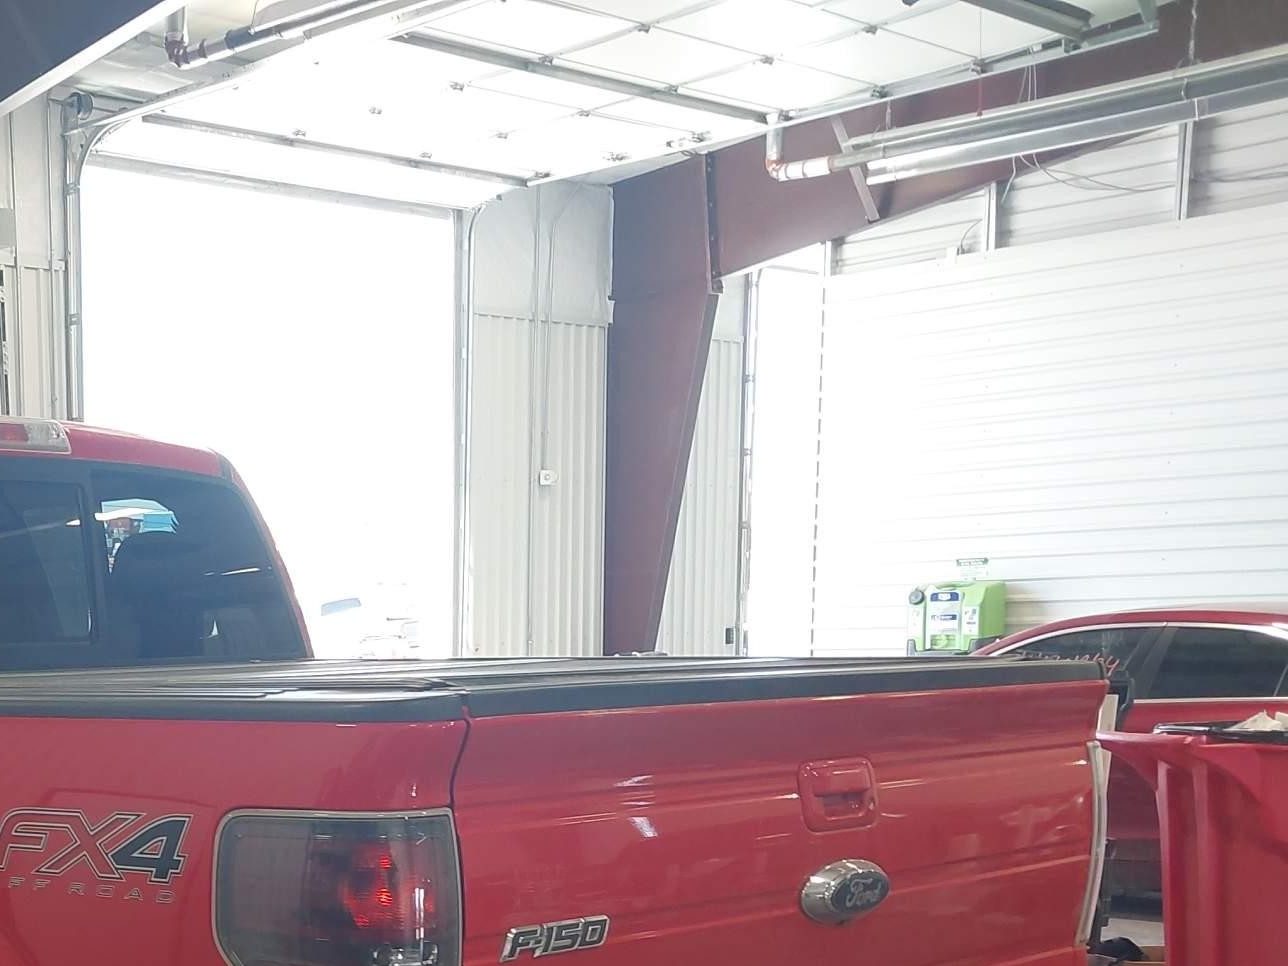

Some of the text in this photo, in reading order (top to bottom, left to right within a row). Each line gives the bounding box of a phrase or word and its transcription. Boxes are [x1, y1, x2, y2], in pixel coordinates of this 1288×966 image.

[67, 882, 177, 904] ROAD
[845, 877, 883, 909] Ford
[499, 914, 611, 963] F-150
